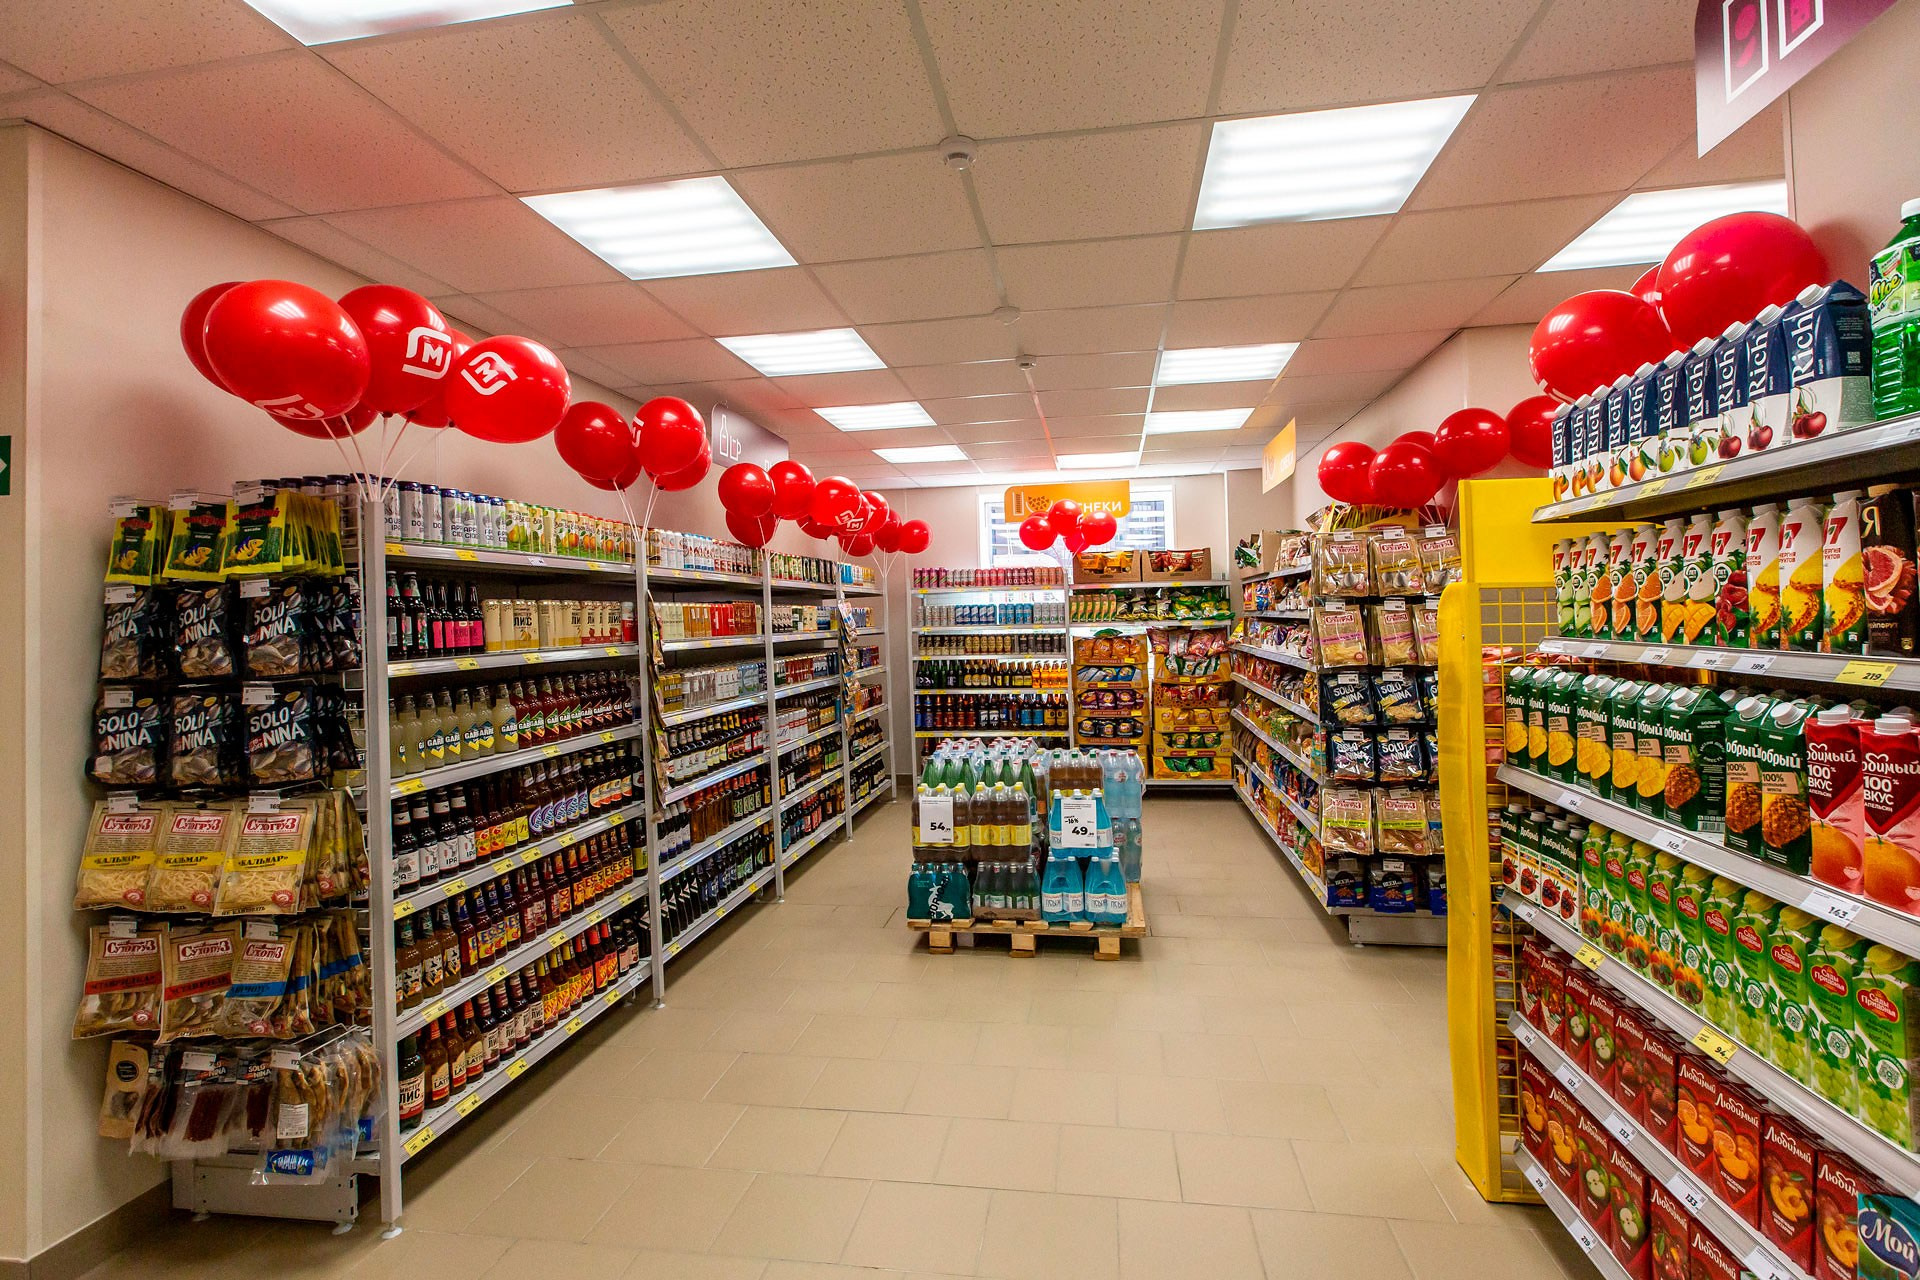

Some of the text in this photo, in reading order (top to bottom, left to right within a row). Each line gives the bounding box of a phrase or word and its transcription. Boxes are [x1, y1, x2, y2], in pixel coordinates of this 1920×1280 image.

[1792, 311, 1815, 385] Rich
[1718, 348, 1736, 411] Rich
[1749, 331, 1769, 398] Rich
[1659, 372, 1675, 431] Rich
[1690, 361, 1704, 421] Rich
[1609, 394, 1622, 449] Rich
[1629, 384, 1645, 440] Rich
[1553, 419, 1563, 464] Rich
[1572, 411, 1584, 461] Rich
[1589, 404, 1600, 456] Rich
[1079, 501, 1122, 513] НЕКИ
[1861, 506, 1880, 539] Я
[178, 602, 208, 629] SOLO
[254, 600, 285, 625] SOLO
[184, 618, 220, 644] NINA
[260, 615, 296, 641] NINA
[98, 708, 139, 735] SOLO
[175, 707, 206, 734] SOLO
[250, 706, 290, 733] SOLO
[105, 728, 152, 751] NINA
[181, 727, 216, 751] NINA
[262, 722, 306, 749] NINA
[1808, 778, 1833, 792] ВКУС
[1864, 790, 1895, 805] ВКУС
[1864, 802, 1893, 813] АПЕЛЬСИН
[1814, 972, 1846, 992] Придонья
[1860, 996, 1897, 1018] Придонья
[1643, 1038, 1674, 1066] Любимый
[1678, 1063, 1716, 1095] Любимый
[1715, 1092, 1760, 1129] Любимый
[1764, 1126, 1812, 1164] Любимый
[1611, 1150, 1643, 1187] Любимый
[1652, 1189, 1689, 1231] Любимый
[1685, 1193, 1699, 1207] 133
[1692, 1233, 1737, 1279] Любимый
[1860, 1219, 1916, 1263] Мой
